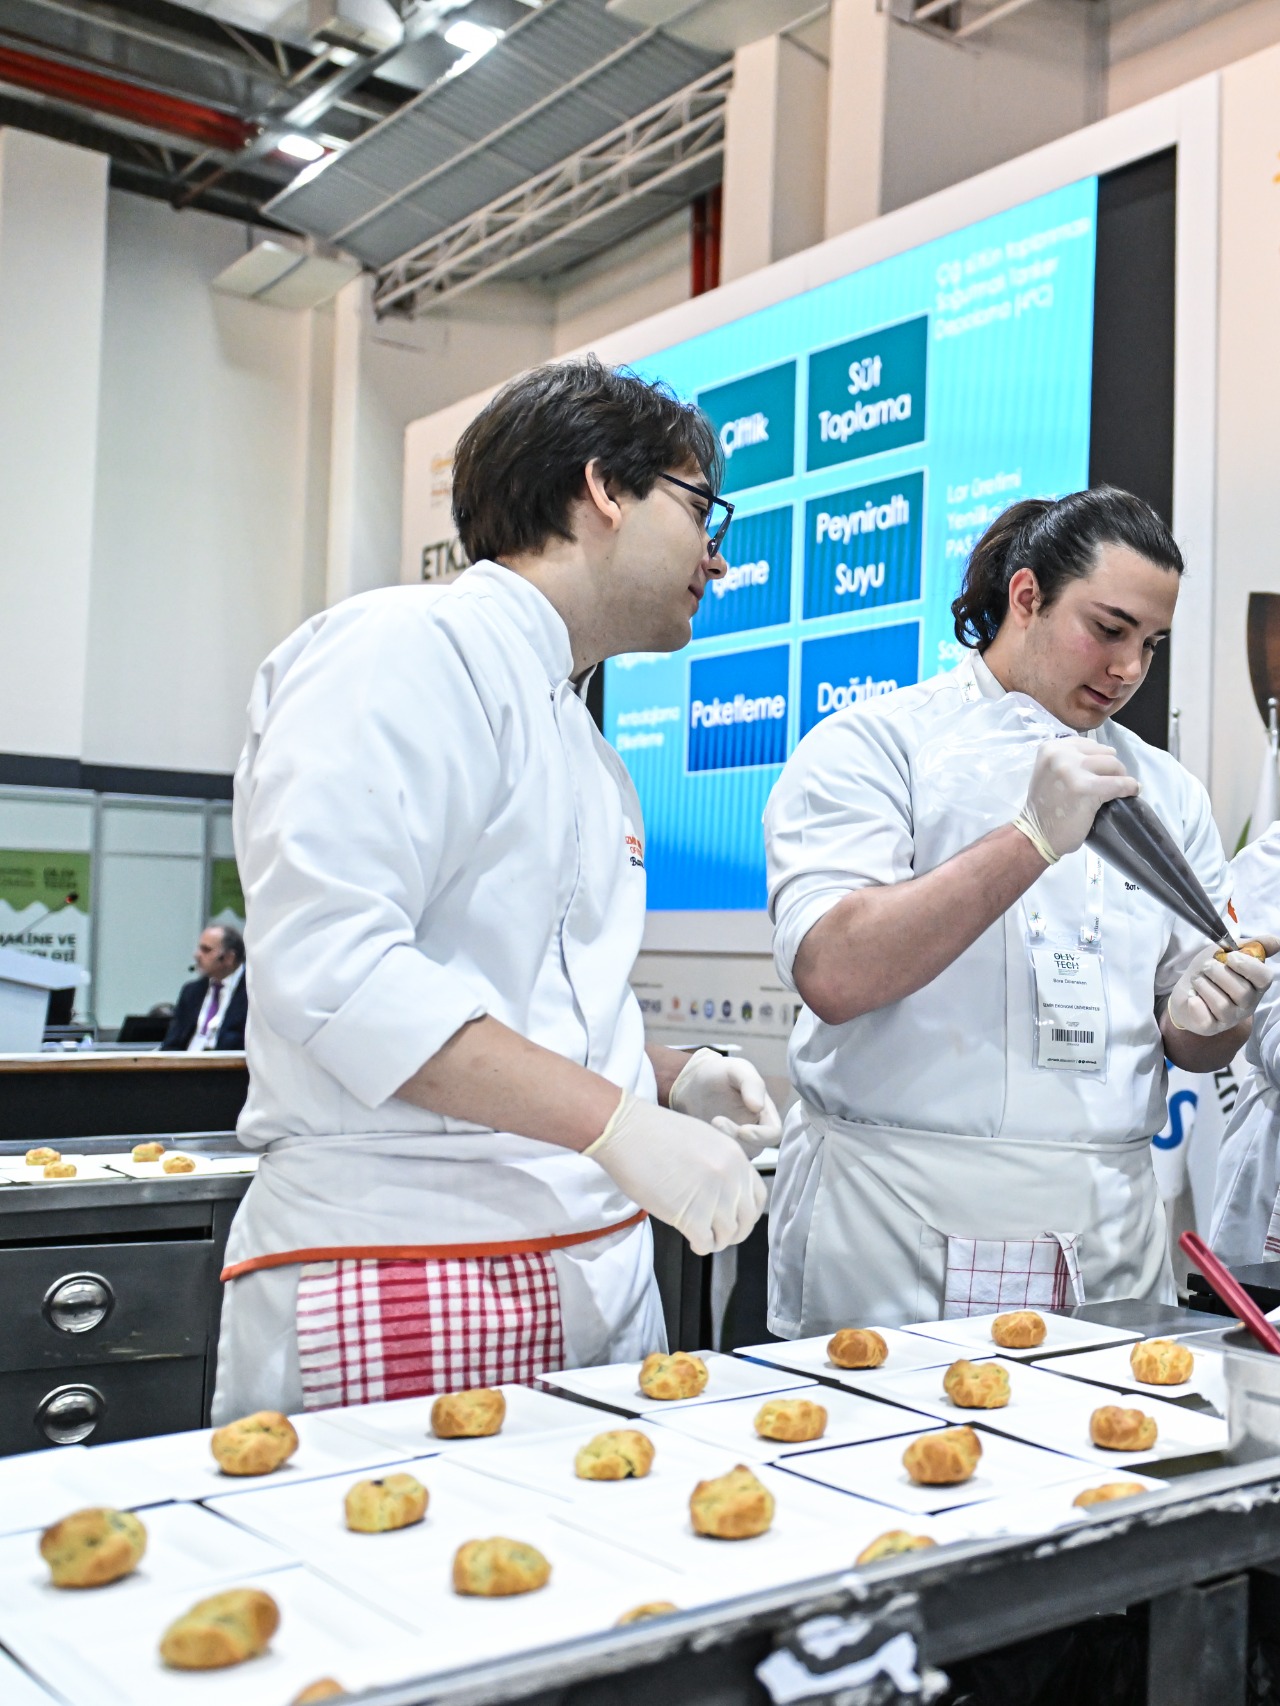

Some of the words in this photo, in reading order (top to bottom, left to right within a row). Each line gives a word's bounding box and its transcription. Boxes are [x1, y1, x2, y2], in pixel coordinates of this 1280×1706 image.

[847, 355, 882, 395] Süt
[818, 393, 912, 443] Toplama
[834, 562, 886, 597] Suyu
[691, 693, 786, 729] Paketleme
[1053, 960, 1080, 970] TECH
